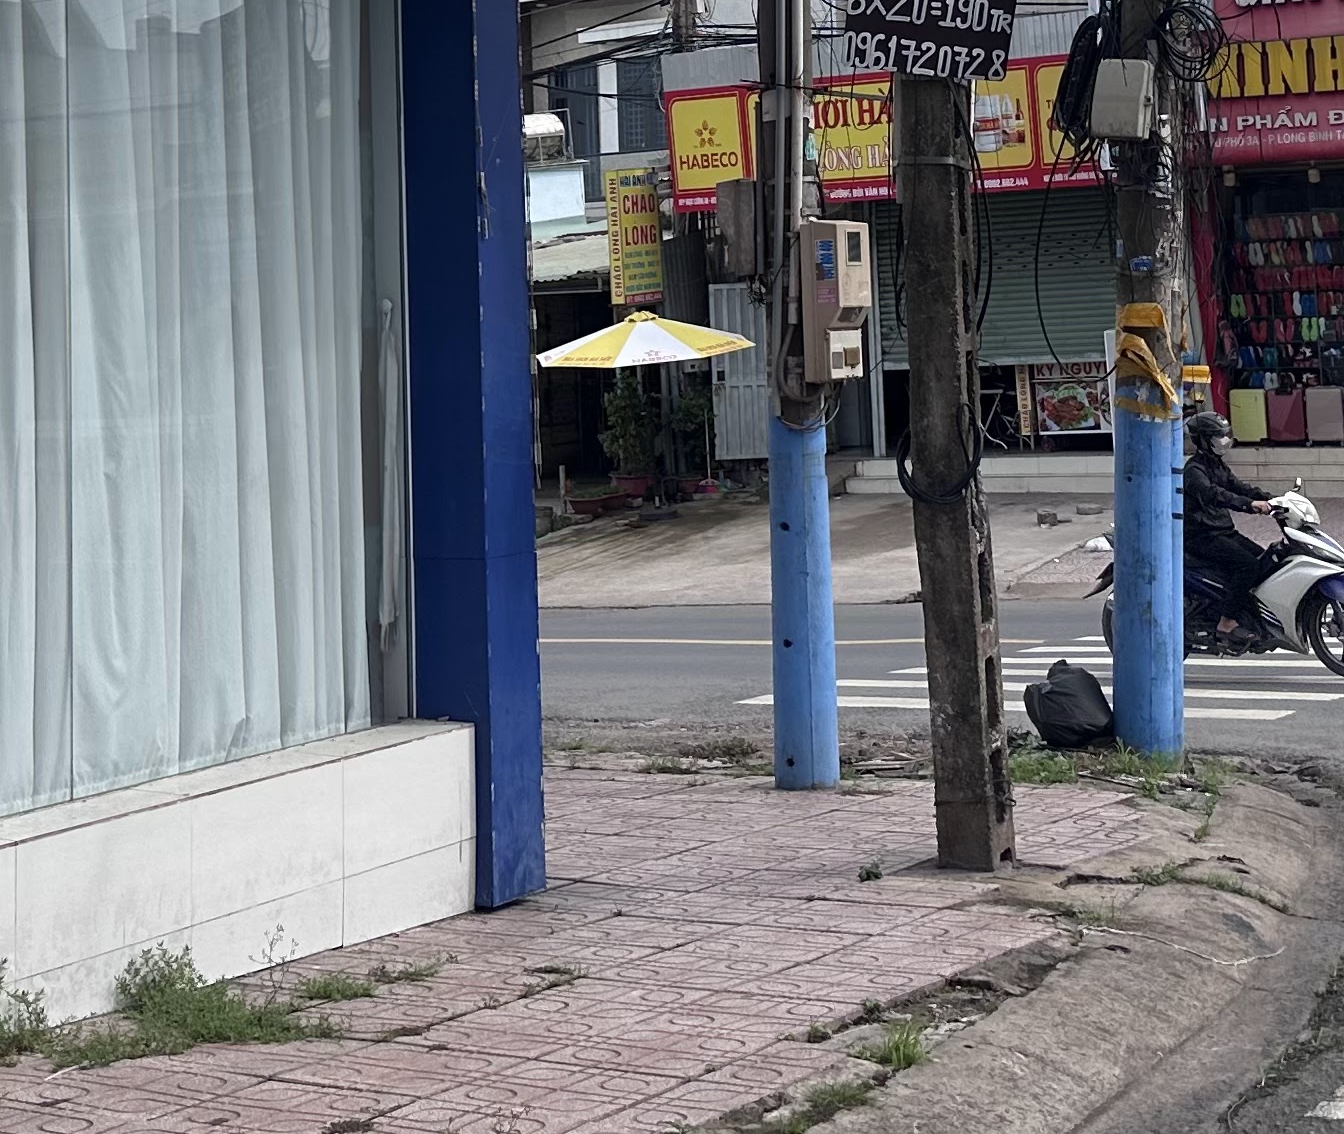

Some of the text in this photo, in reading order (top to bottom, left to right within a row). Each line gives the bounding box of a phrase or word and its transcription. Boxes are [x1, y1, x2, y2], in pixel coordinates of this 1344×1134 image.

[841, 30, 1007, 82] 0961720728
[679, 152, 739, 170] HABECO
[1060, 362, 1108, 376] NGUY
